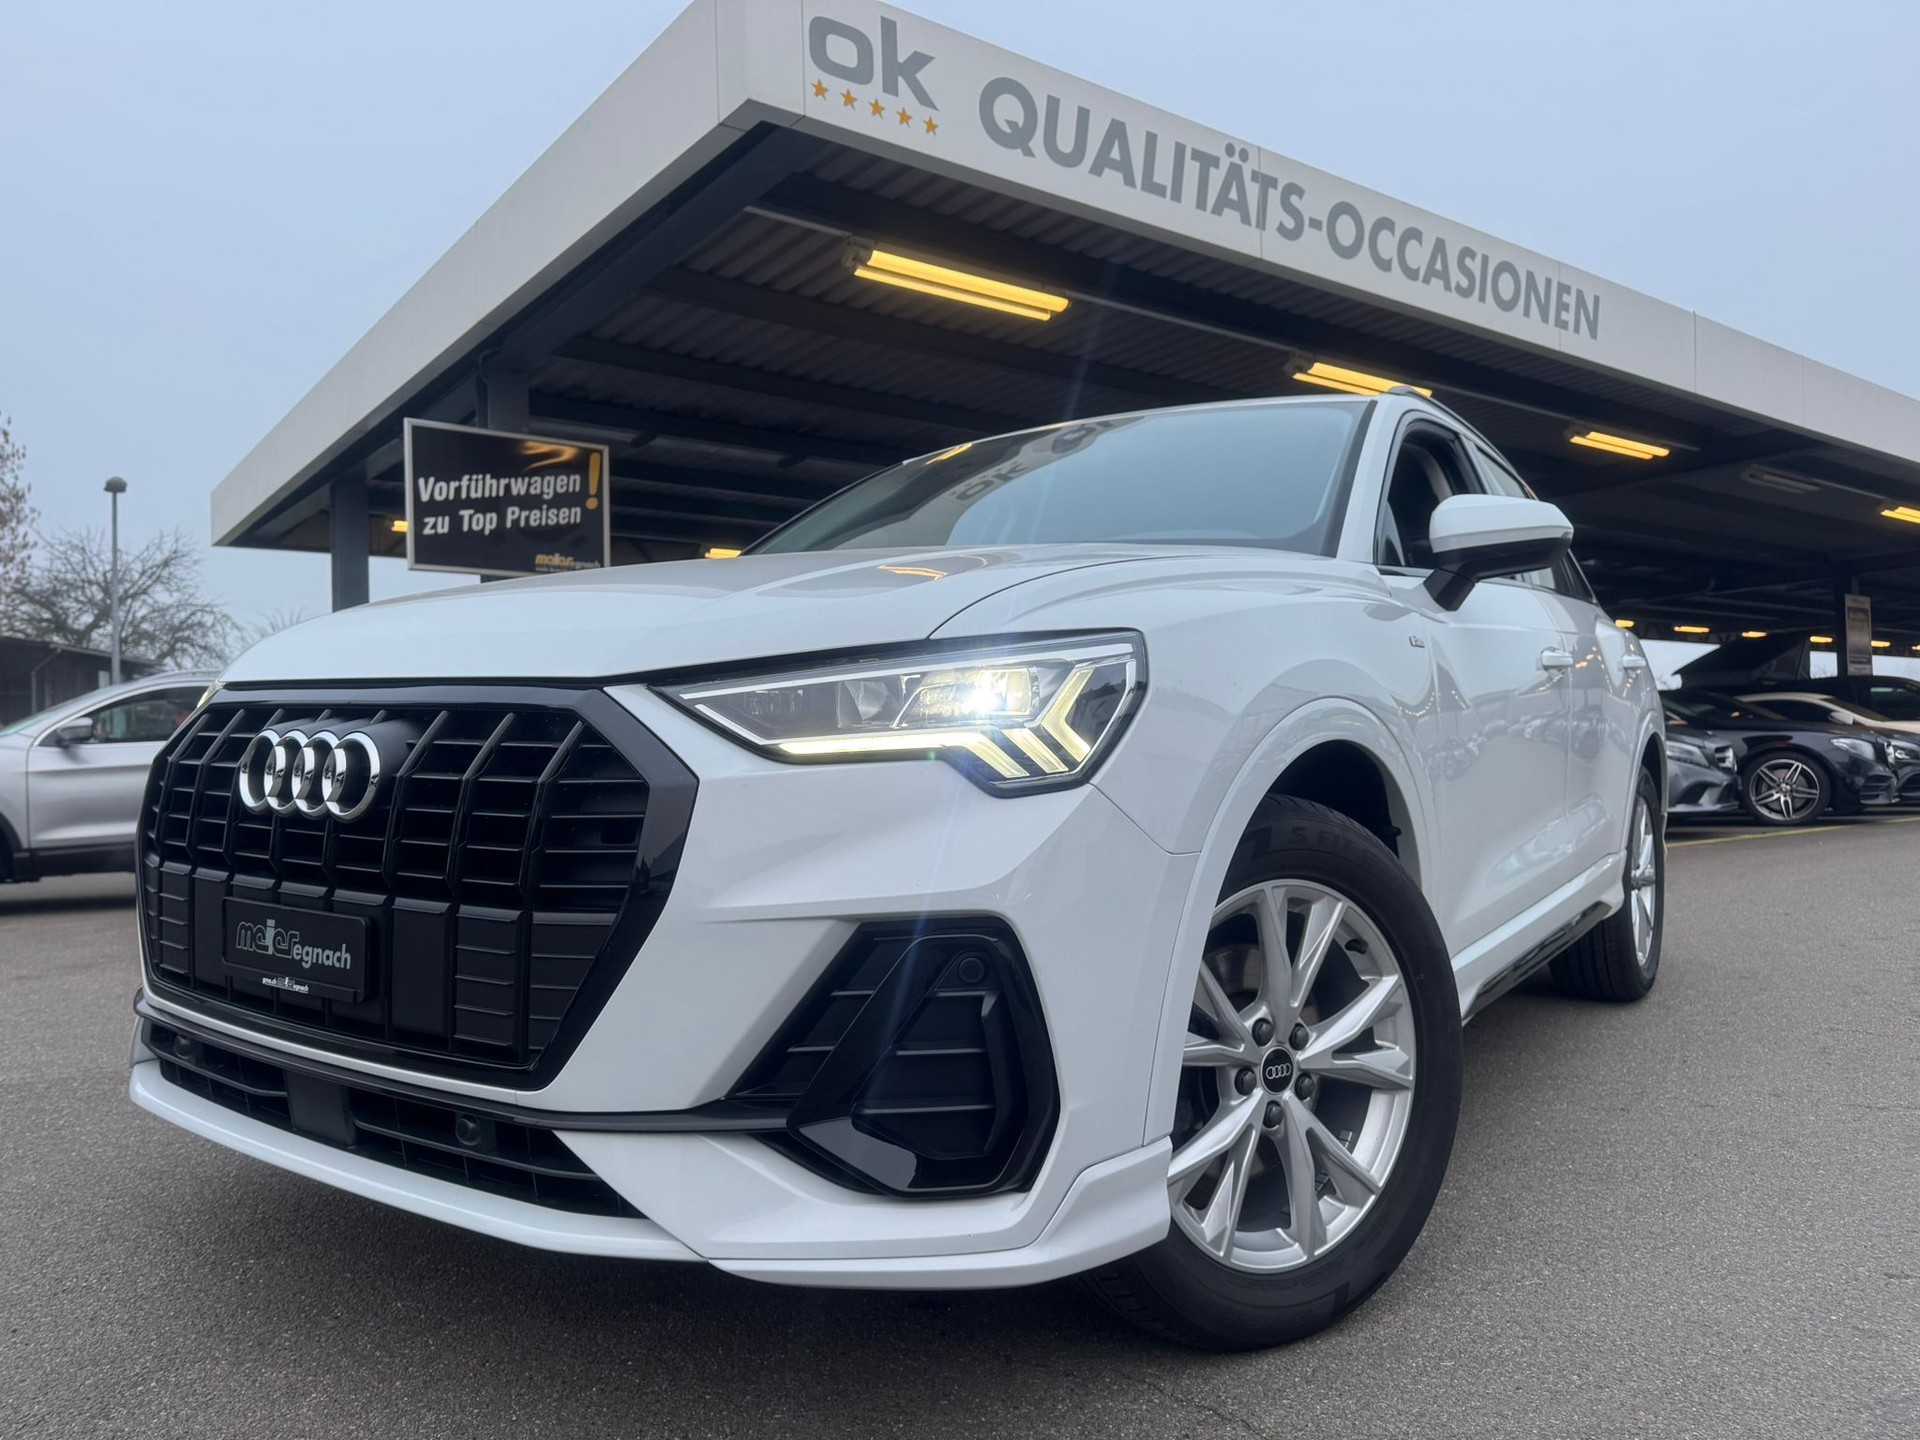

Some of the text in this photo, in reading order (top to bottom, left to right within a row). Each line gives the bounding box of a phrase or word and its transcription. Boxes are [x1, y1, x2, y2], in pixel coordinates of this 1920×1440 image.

[808, 15, 1600, 340] ok QUALITÄTS-OCCASIONEN
[418, 473, 581, 502] Vorführwagen
[422, 504, 581, 535] zu Top Preisen
